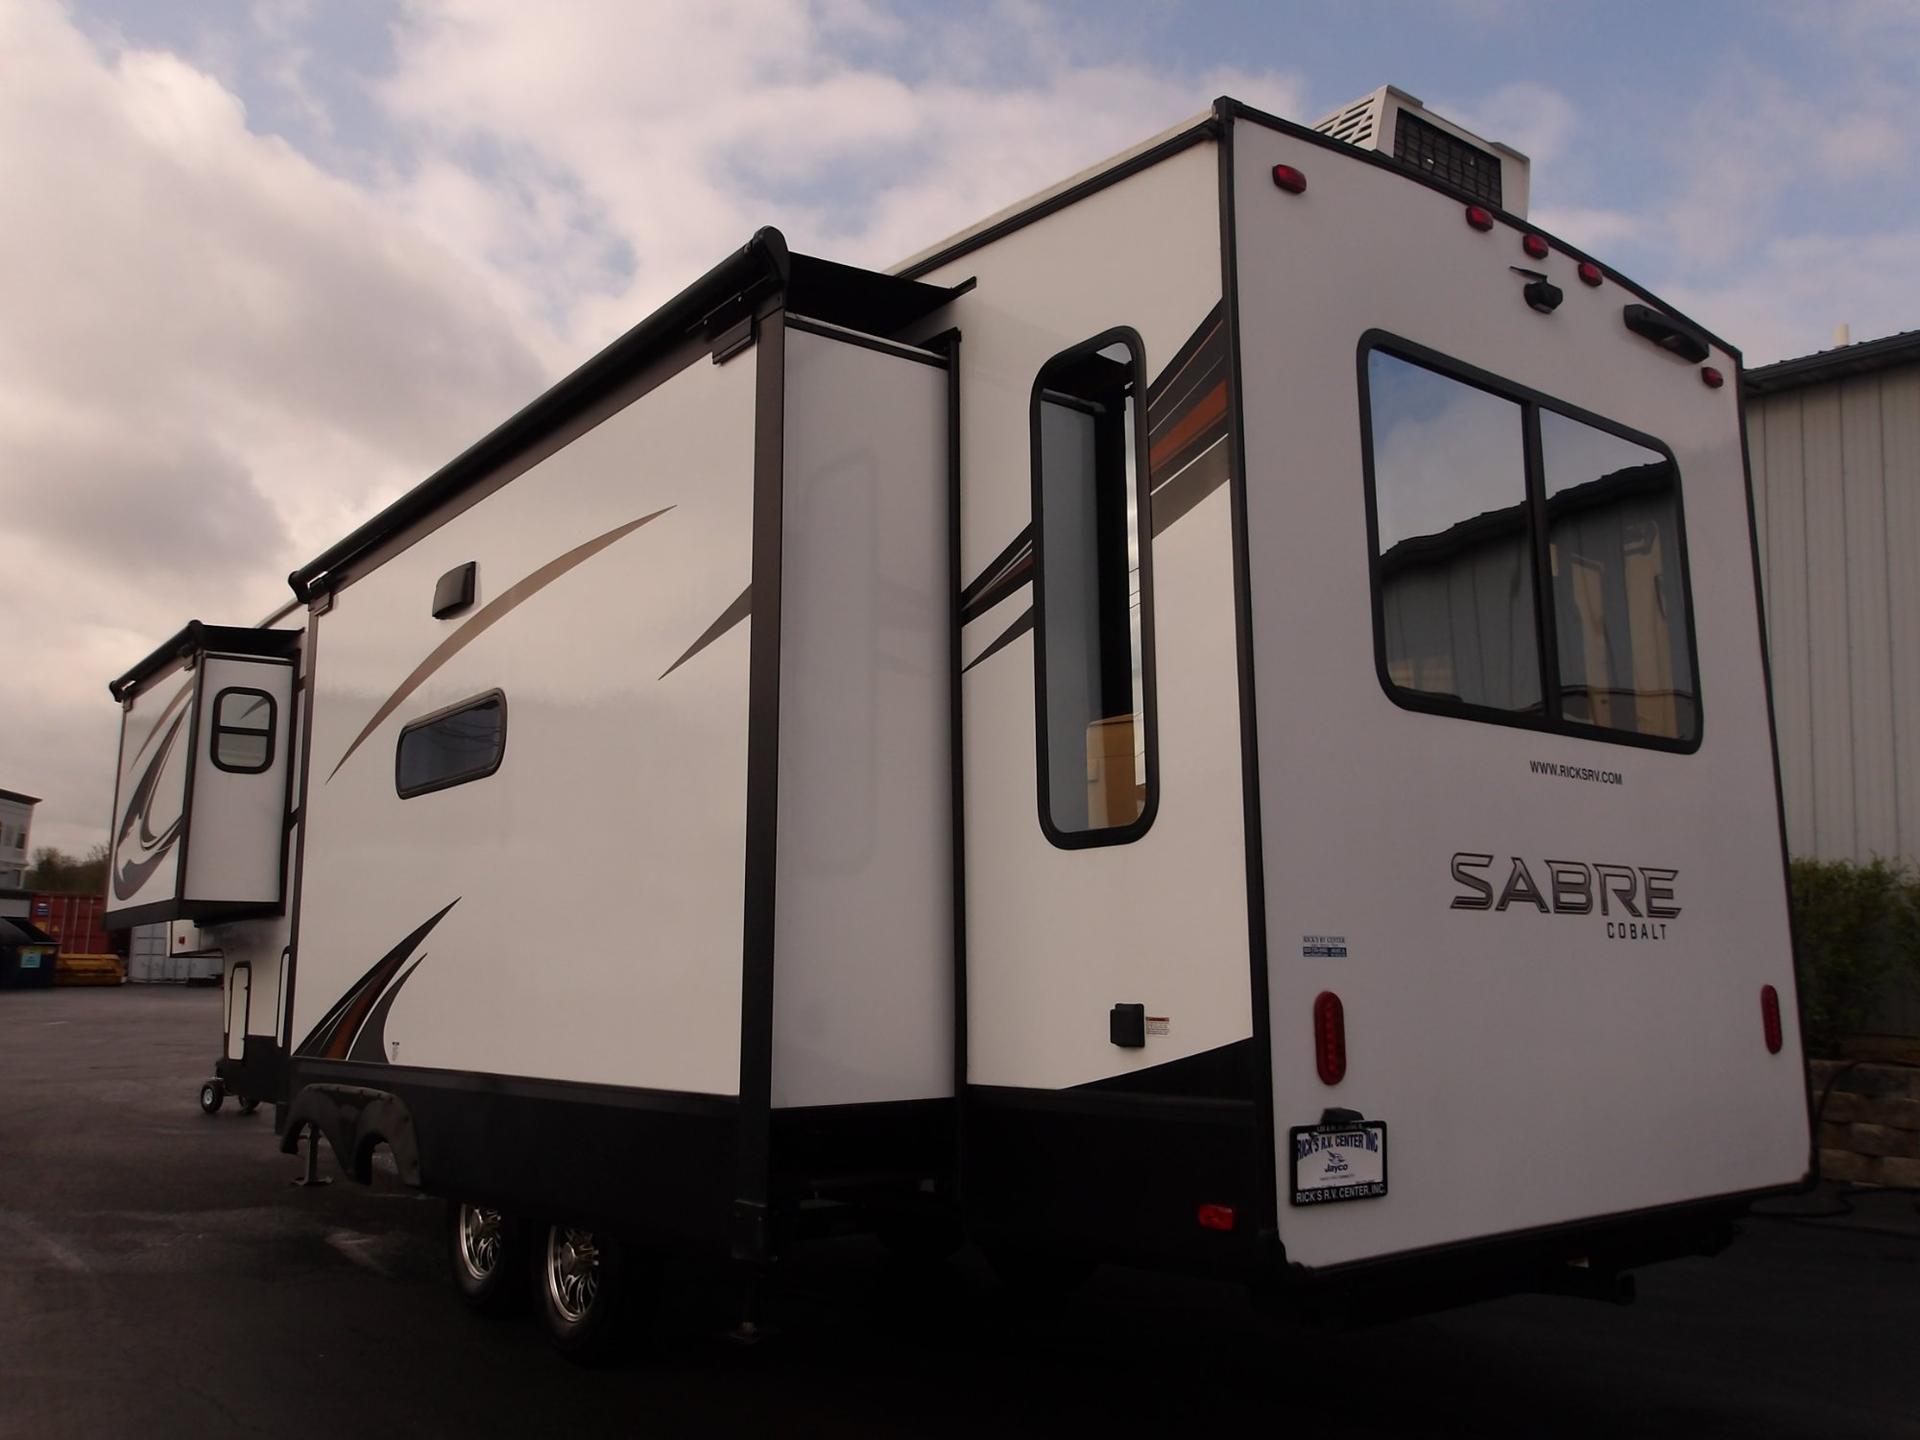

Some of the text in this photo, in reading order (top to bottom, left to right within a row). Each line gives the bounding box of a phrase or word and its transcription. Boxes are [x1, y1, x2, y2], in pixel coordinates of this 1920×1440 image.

[1530, 760, 1622, 785] WWW.RICKSRV.COM
[1450, 852, 1682, 919] SABRE
[1607, 923, 1666, 940] COBALT
[1335, 1135, 1364, 1149] CENTER
[1325, 1163, 1348, 1173] Jayco
